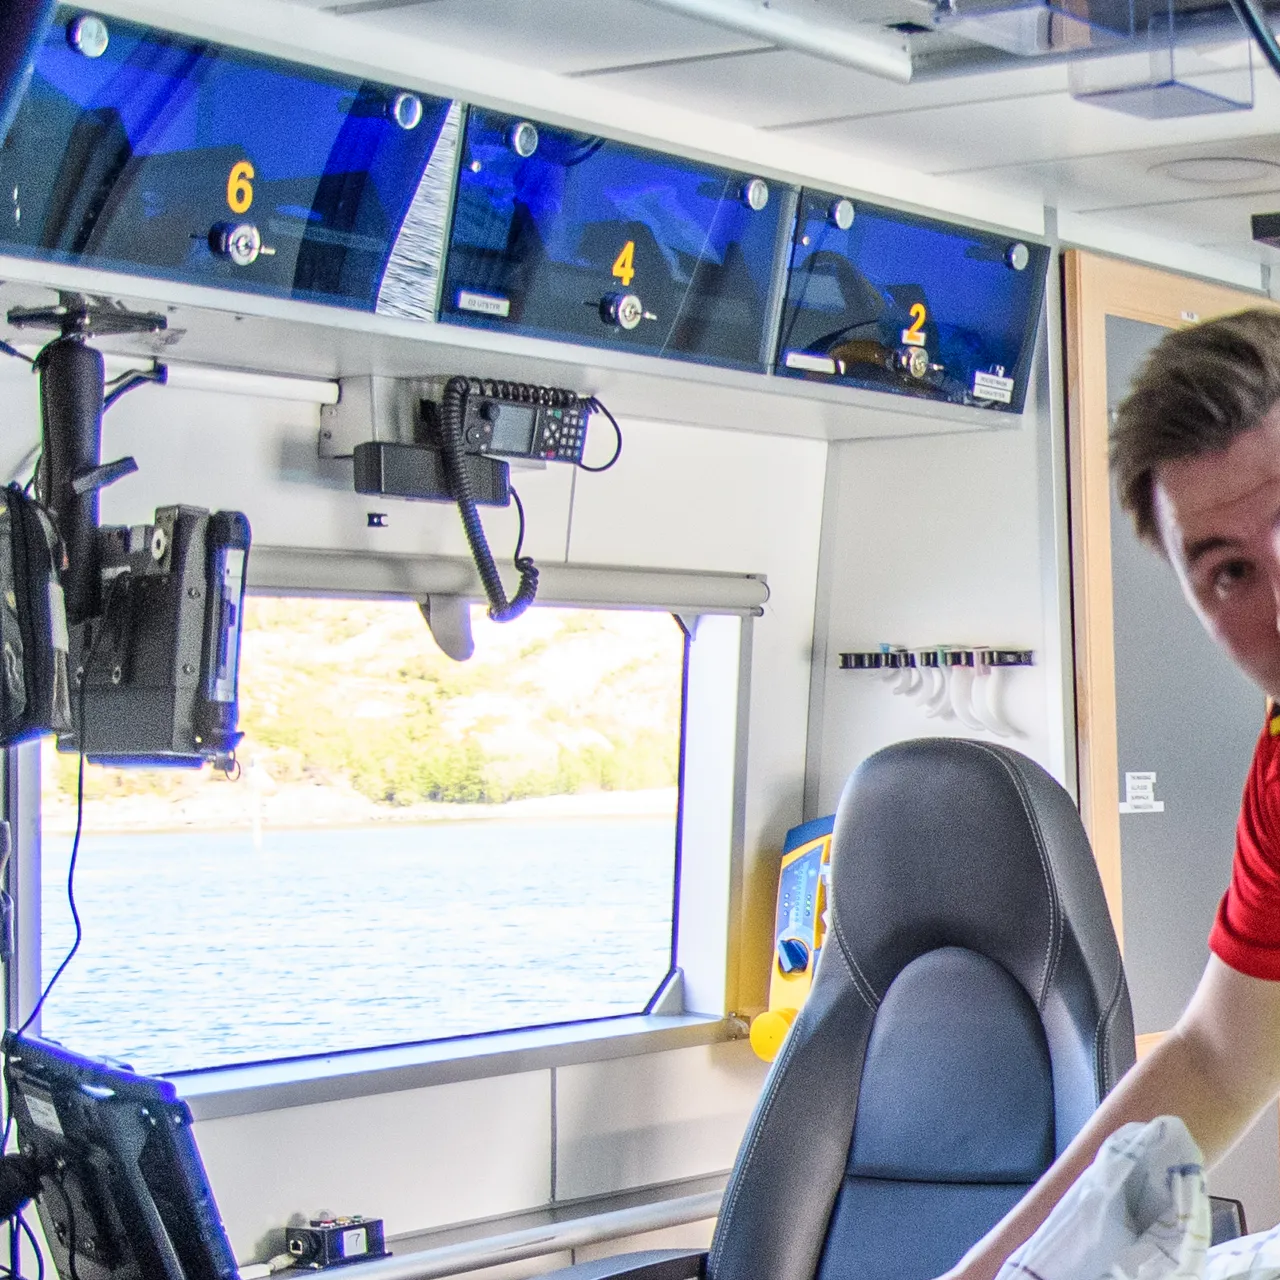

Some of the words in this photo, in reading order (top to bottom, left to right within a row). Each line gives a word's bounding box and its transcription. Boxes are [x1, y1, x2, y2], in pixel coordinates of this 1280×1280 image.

[226, 160, 255, 214] 6
[611, 241, 636, 286] 4
[906, 302, 927, 342] 2
